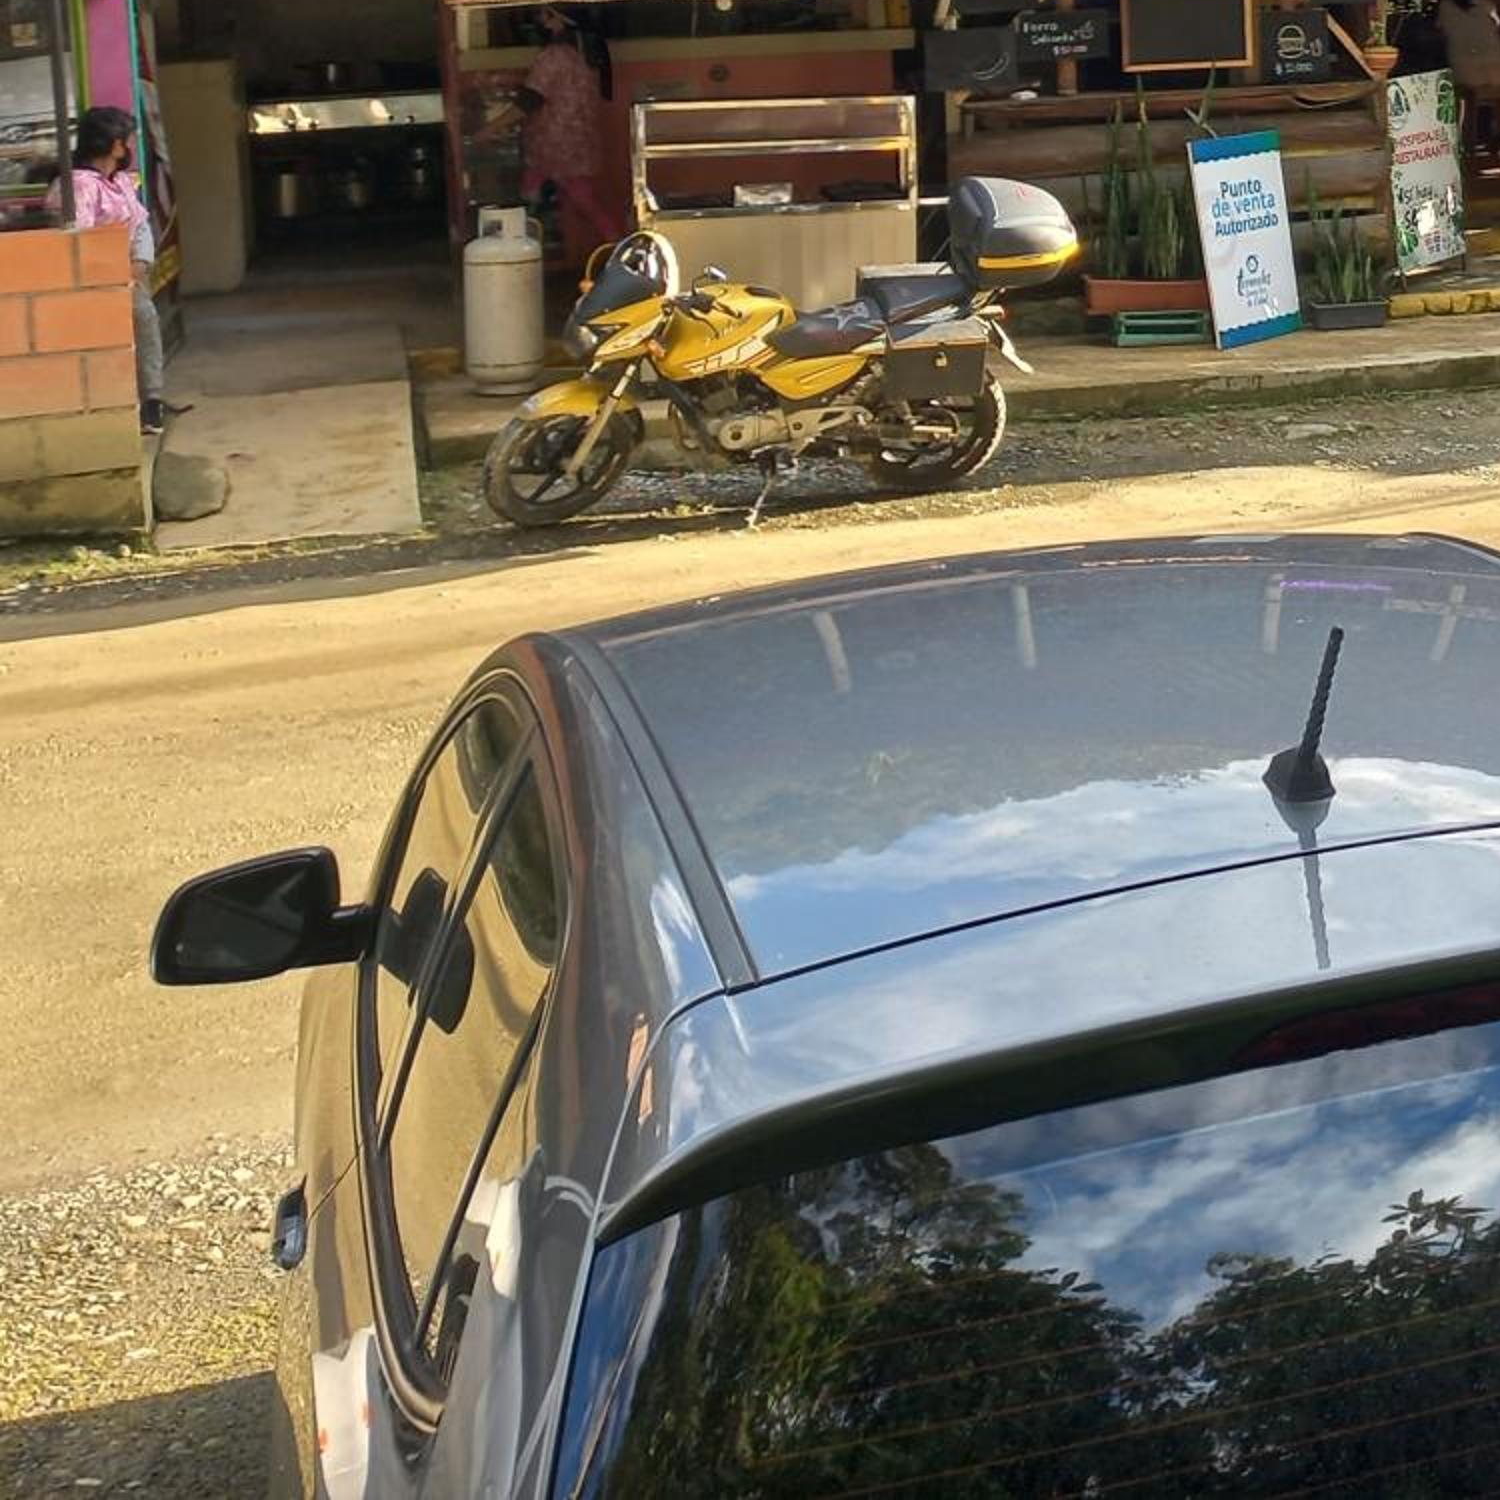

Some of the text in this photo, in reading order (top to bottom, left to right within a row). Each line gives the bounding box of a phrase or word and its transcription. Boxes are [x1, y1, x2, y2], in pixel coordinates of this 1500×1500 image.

[1220, 180, 1262, 198] Punto
[1212, 193, 1276, 218] de venta
[1216, 210, 1279, 236] Autorizado
